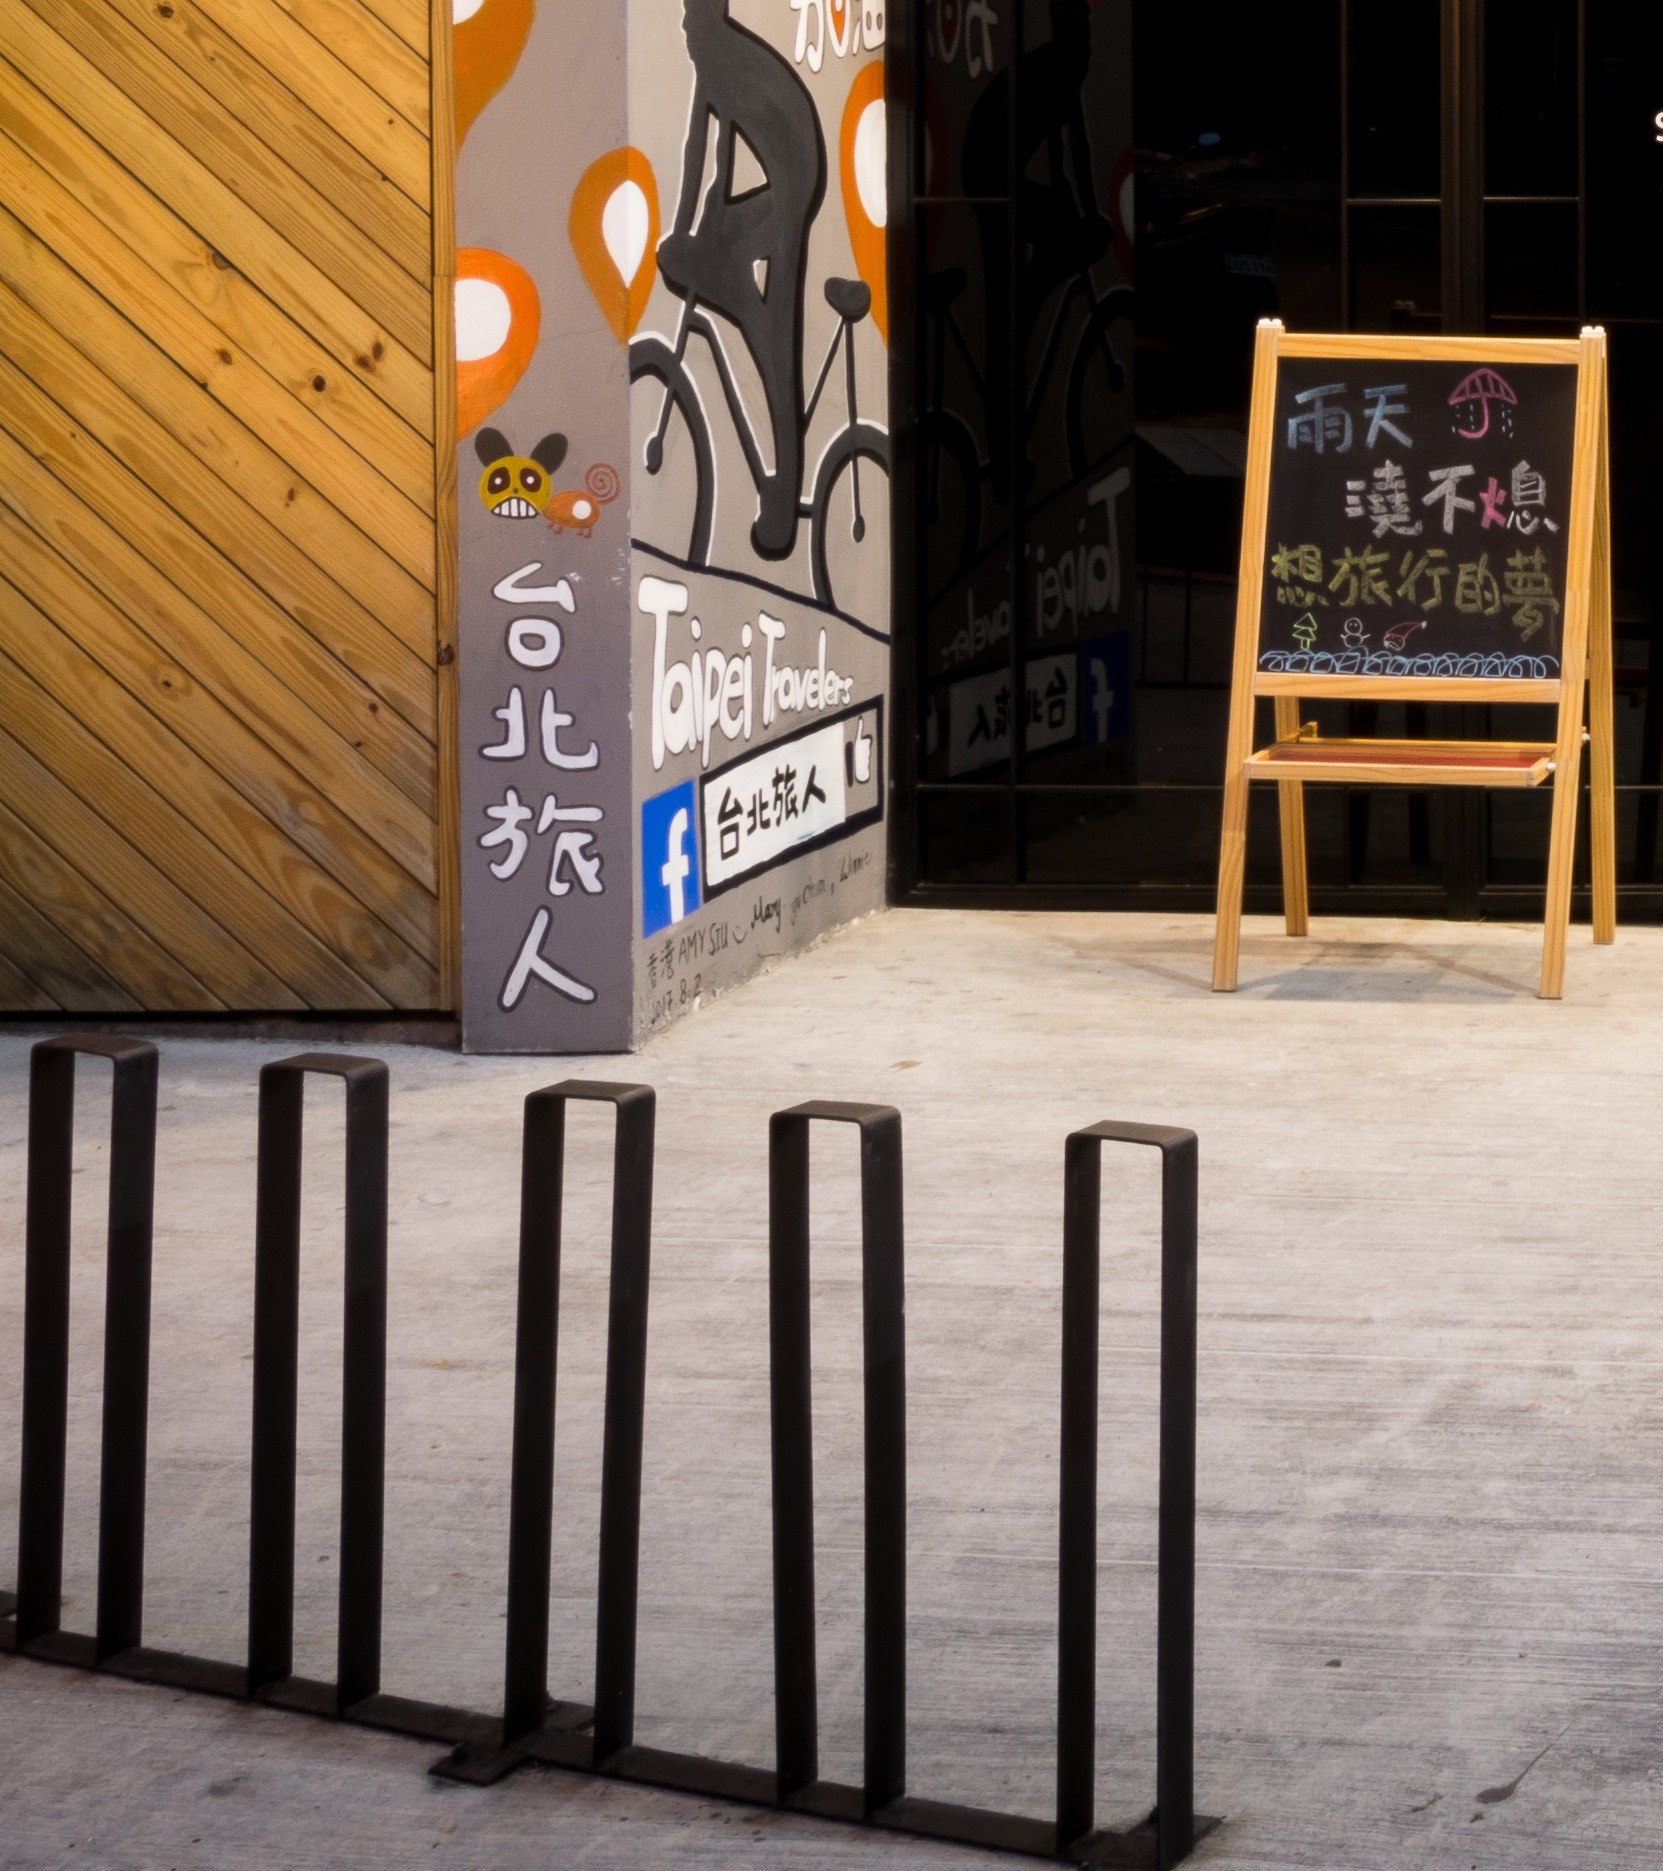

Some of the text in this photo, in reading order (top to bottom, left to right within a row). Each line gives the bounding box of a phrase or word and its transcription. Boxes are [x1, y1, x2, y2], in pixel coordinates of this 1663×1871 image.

[1287, 383, 1413, 454] 雨天
[1270, 543, 1560, 642] 想旅行的夢
[636, 575, 855, 771] Taipei Travelers
[480, 561, 604, 1010] 台北旅人
[716, 763, 827, 862] 台北旅人
